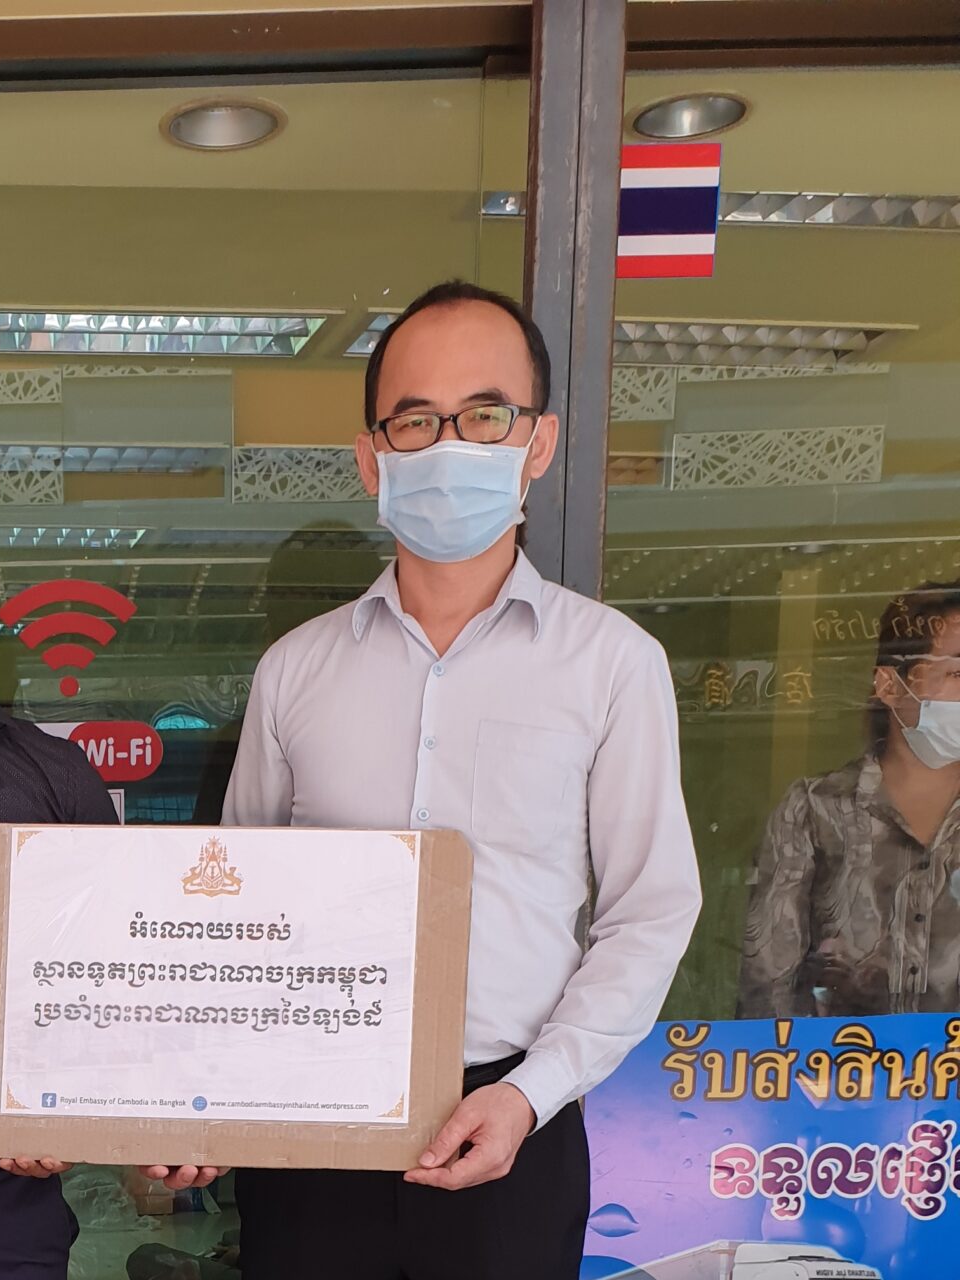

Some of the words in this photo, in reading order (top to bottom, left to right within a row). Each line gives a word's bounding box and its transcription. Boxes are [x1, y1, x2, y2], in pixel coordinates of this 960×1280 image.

[77, 736, 152, 768] Wi-Fi
[129, 911, 292, 941] អំណោយរបស់
[60, 1096, 78, 1105] Royal
[79, 1097, 107, 1106] Embassy
[108, 1097, 116, 1105] of
[117, 1098, 149, 1106] Cambodia
[159, 1099, 186, 1108] Bangkok
